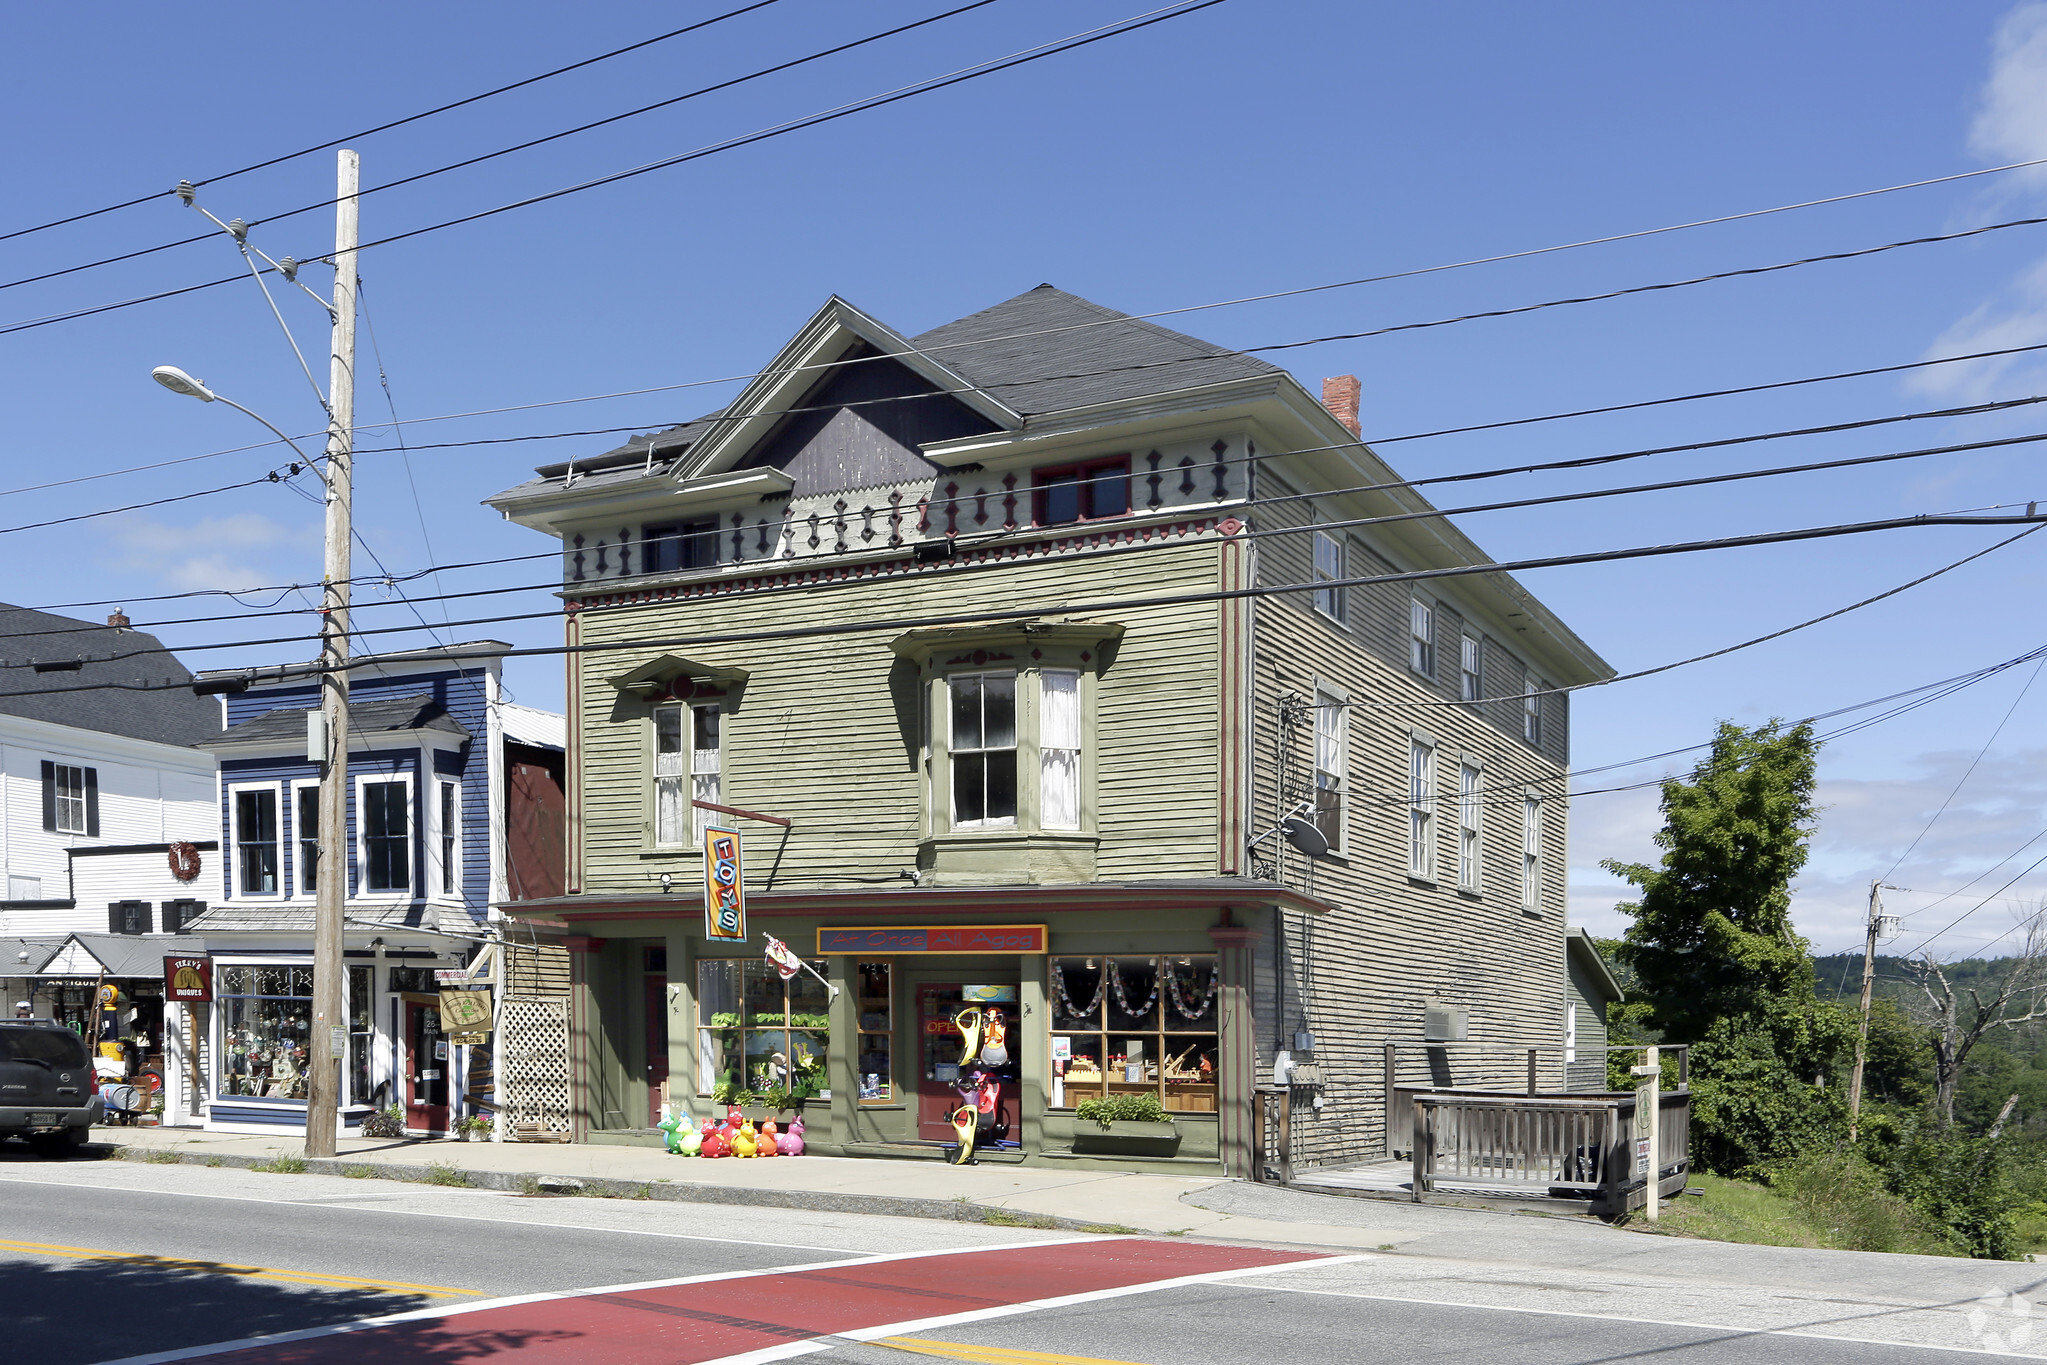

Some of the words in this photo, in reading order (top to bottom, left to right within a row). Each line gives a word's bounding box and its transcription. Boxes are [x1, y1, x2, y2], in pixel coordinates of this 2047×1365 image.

[719, 840, 737, 928] TOYS
[829, 933, 859, 946] At
[866, 931, 925, 946] Once
[932, 932, 961, 946] All
[967, 932, 1033, 949] Agog
[435, 971, 468, 979] COMMERCIAL
[176, 989, 203, 997] UNIQUES
